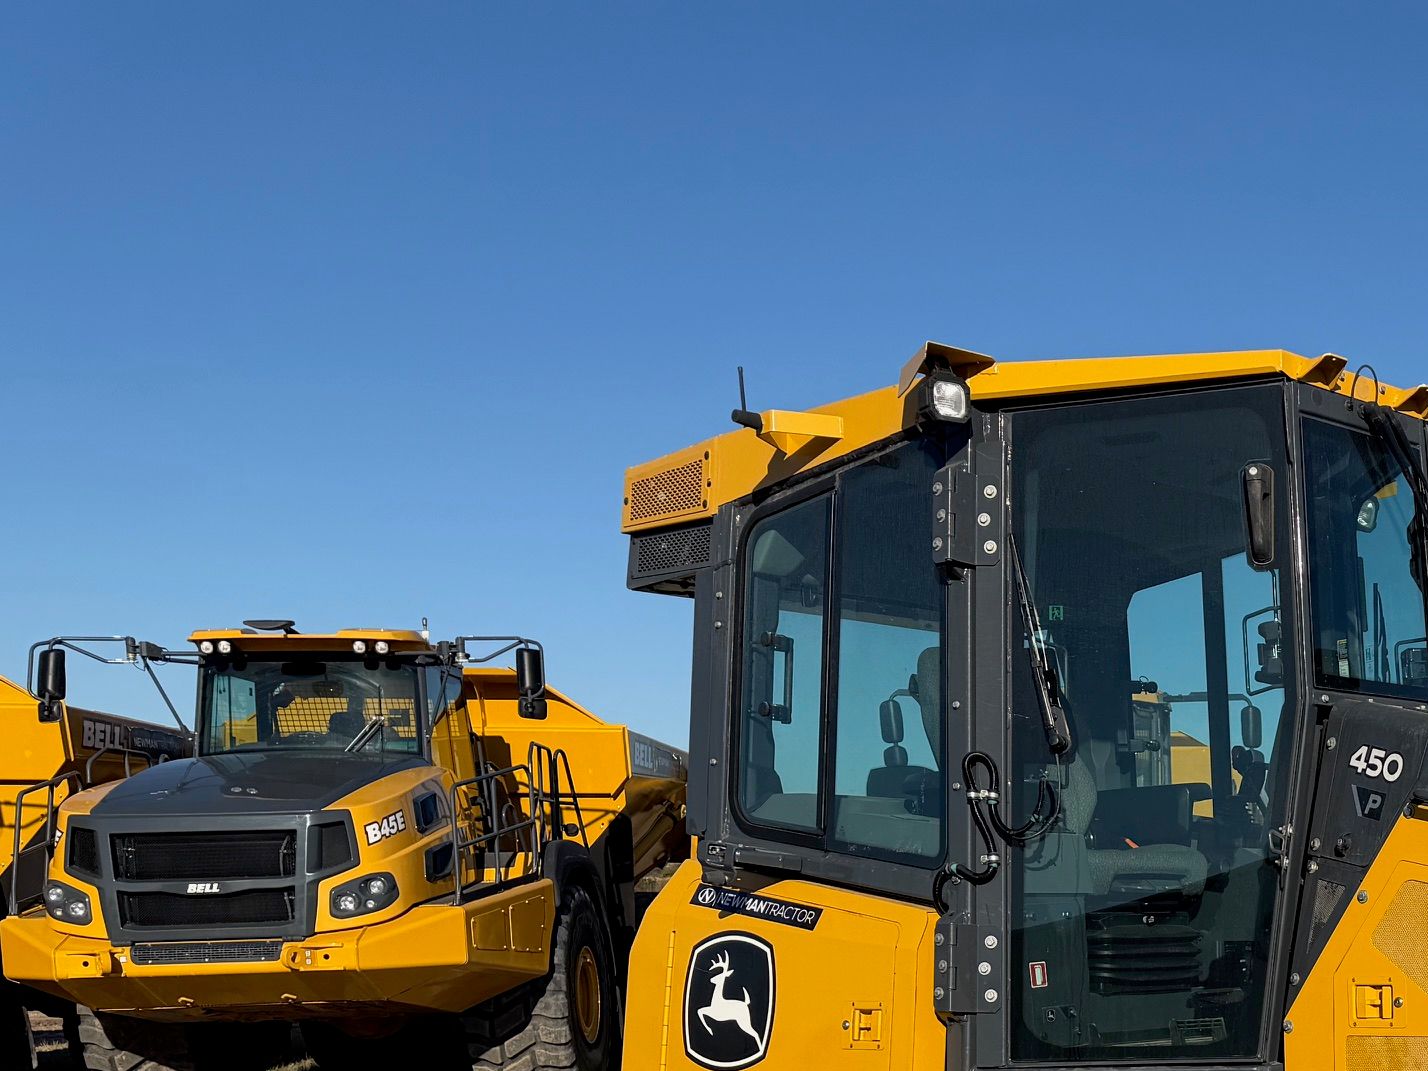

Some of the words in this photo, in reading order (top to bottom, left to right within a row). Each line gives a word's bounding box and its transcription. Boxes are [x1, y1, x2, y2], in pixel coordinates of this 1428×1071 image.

[83, 720, 124, 749] BELL
[635, 742, 653, 768] BELL
[1349, 745, 1404, 782] 450
[1364, 794, 1382, 814] P
[365, 810, 405, 845] B45E
[187, 883, 220, 893] BELL
